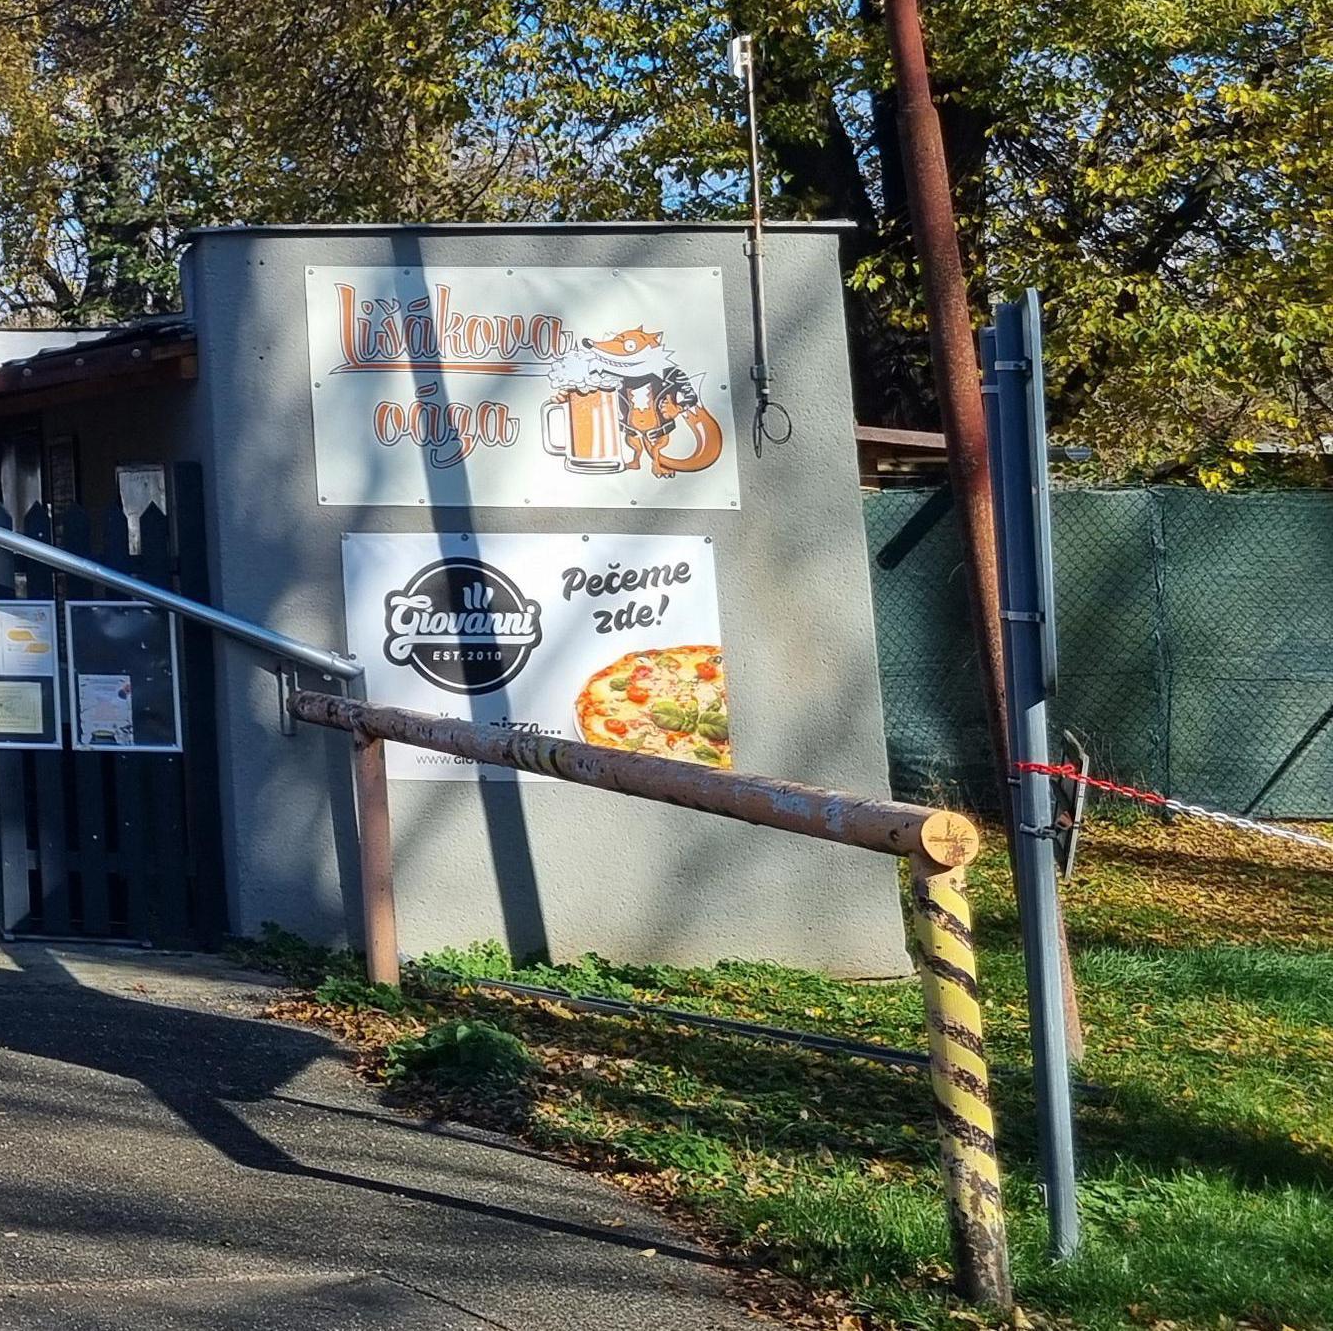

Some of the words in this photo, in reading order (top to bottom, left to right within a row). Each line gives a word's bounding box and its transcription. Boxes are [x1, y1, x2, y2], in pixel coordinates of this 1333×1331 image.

[334, 283, 573, 367] Lišákova
[374, 382, 521, 469] oáza
[561, 562, 692, 602] Pečeme
[592, 594, 670, 635] zde!
[389, 594, 536, 660] Giovanni
